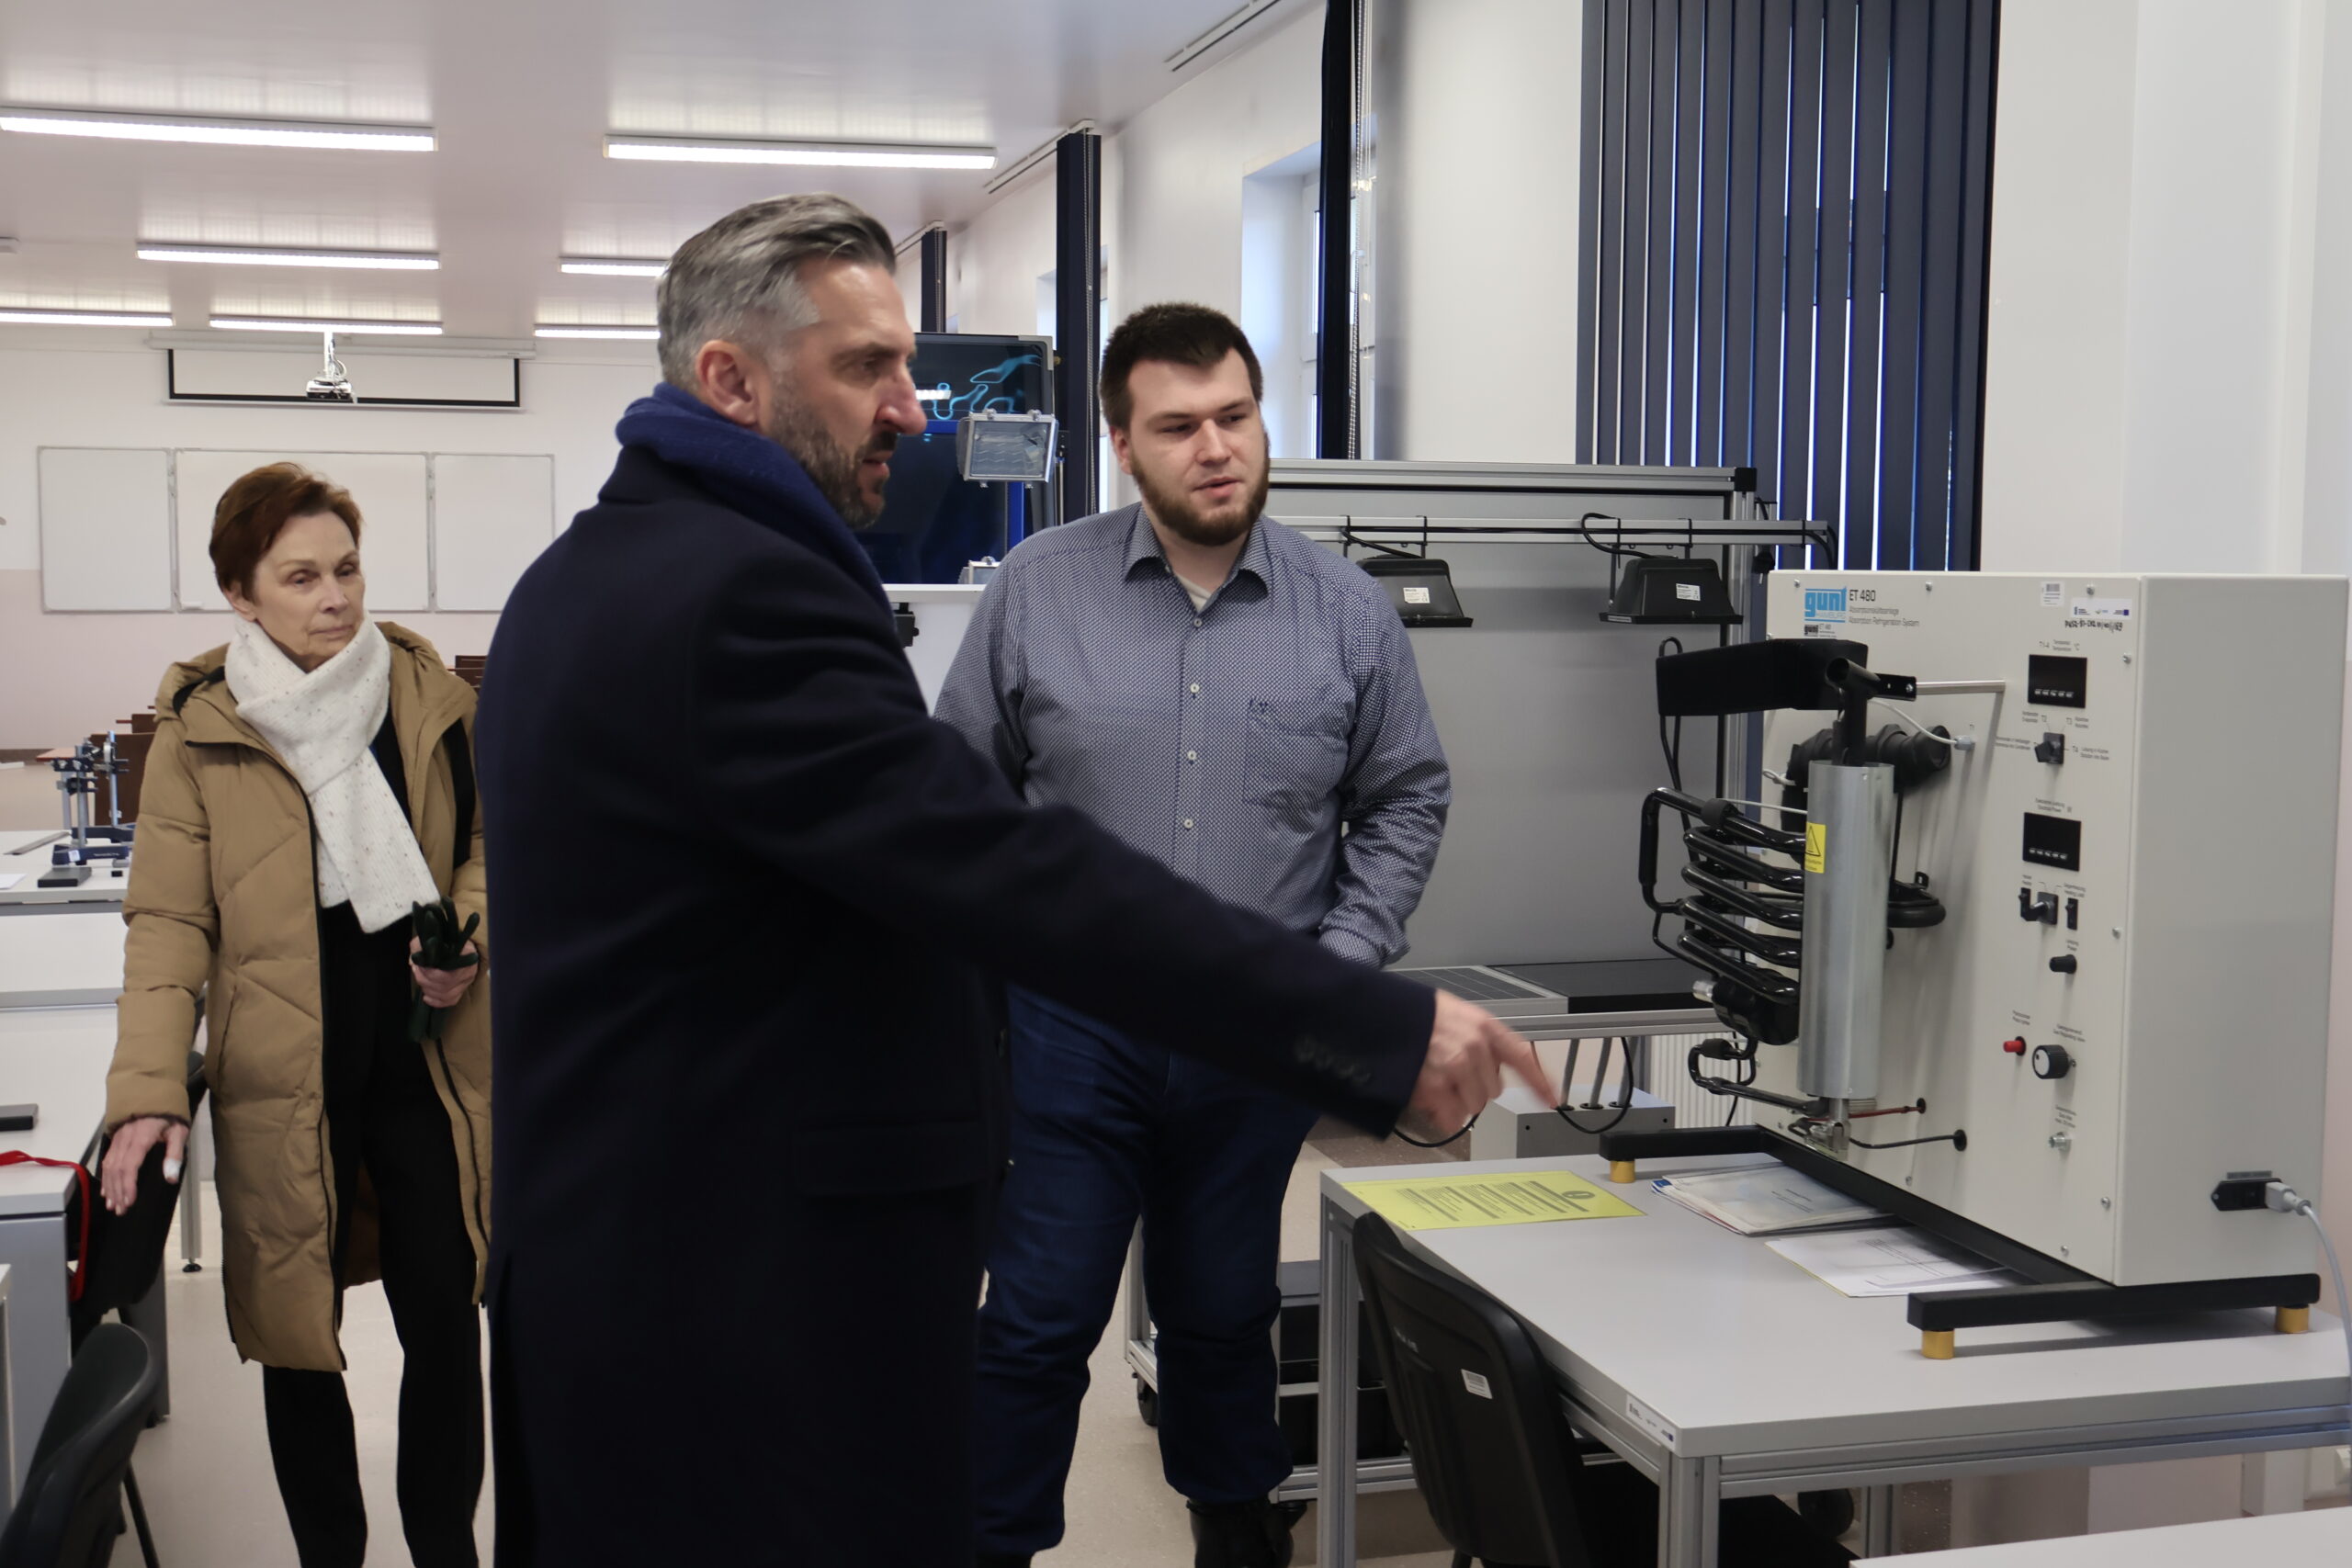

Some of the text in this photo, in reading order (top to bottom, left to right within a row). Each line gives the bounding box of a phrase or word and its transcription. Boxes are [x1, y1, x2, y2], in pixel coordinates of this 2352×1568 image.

[1804, 586, 1847, 617] gunt
[1849, 589, 1876, 602] ET 480
